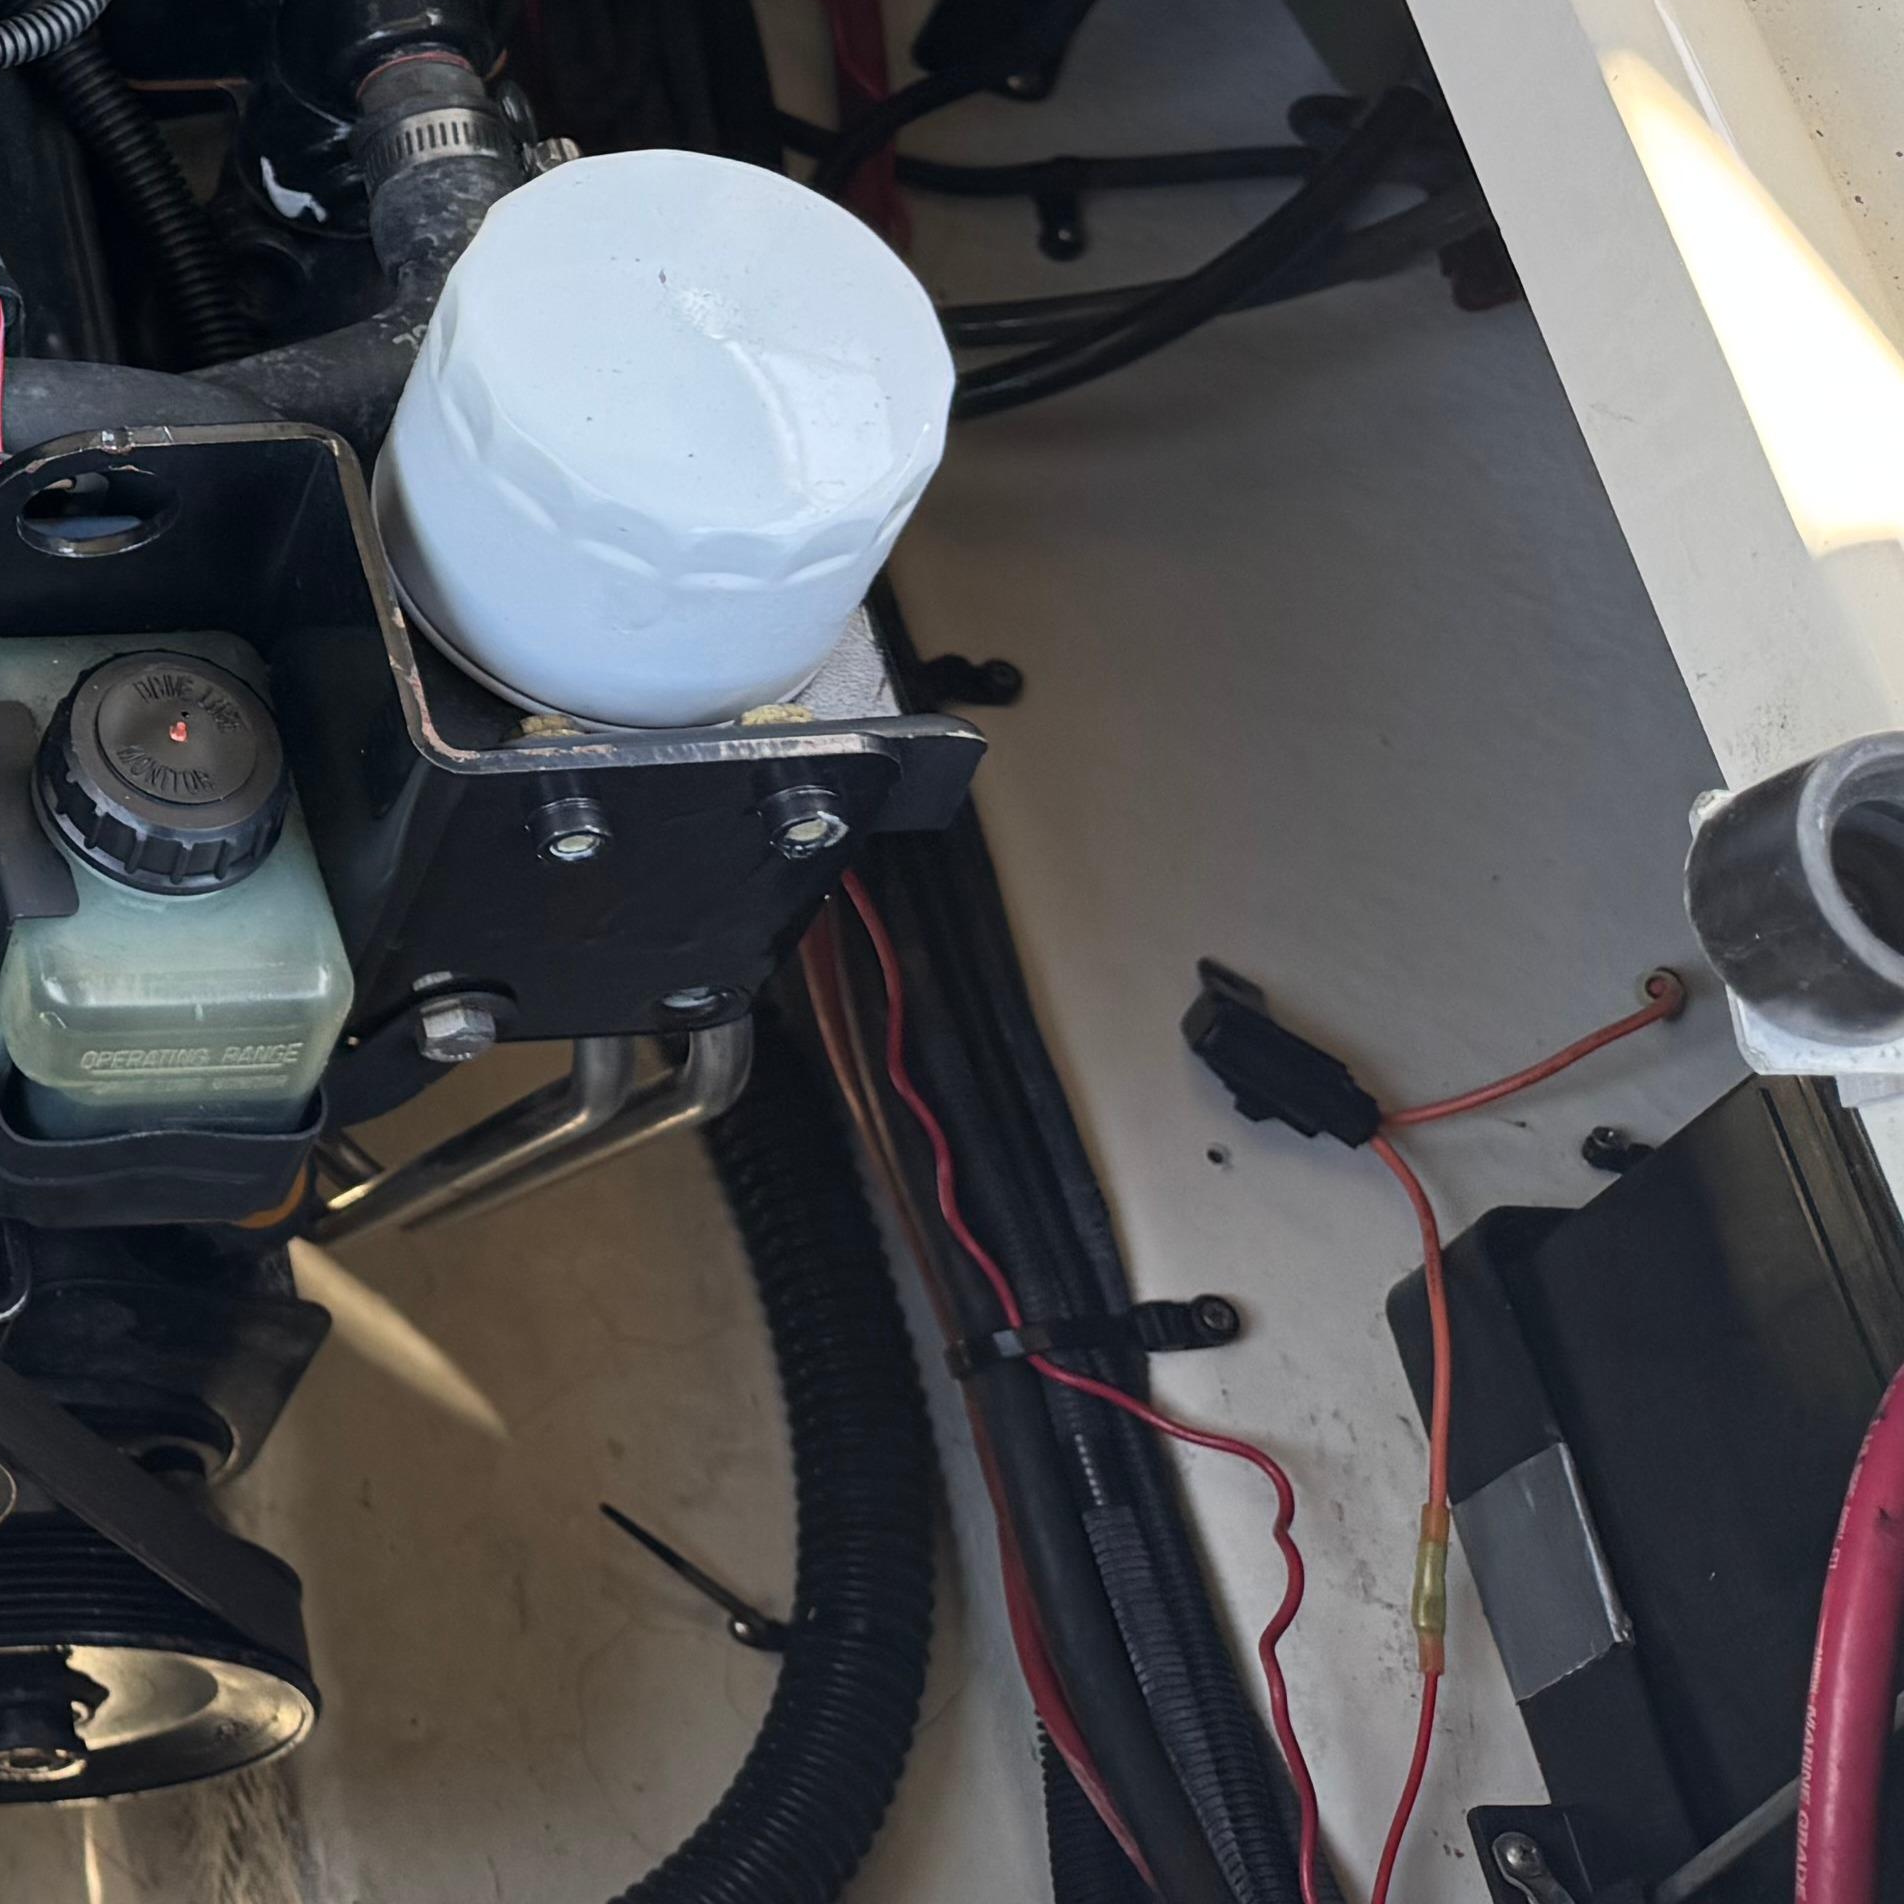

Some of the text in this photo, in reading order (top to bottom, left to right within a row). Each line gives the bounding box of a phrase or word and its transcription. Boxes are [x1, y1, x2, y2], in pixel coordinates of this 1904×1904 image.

[132, 673, 195, 705] DRIVE
[116, 744, 216, 794] MONITOR
[79, 1041, 305, 1071] OPERATING RANGE
[1799, 1704, 1817, 1806] MARINE
[1794, 1808, 1810, 1902] GRADE
